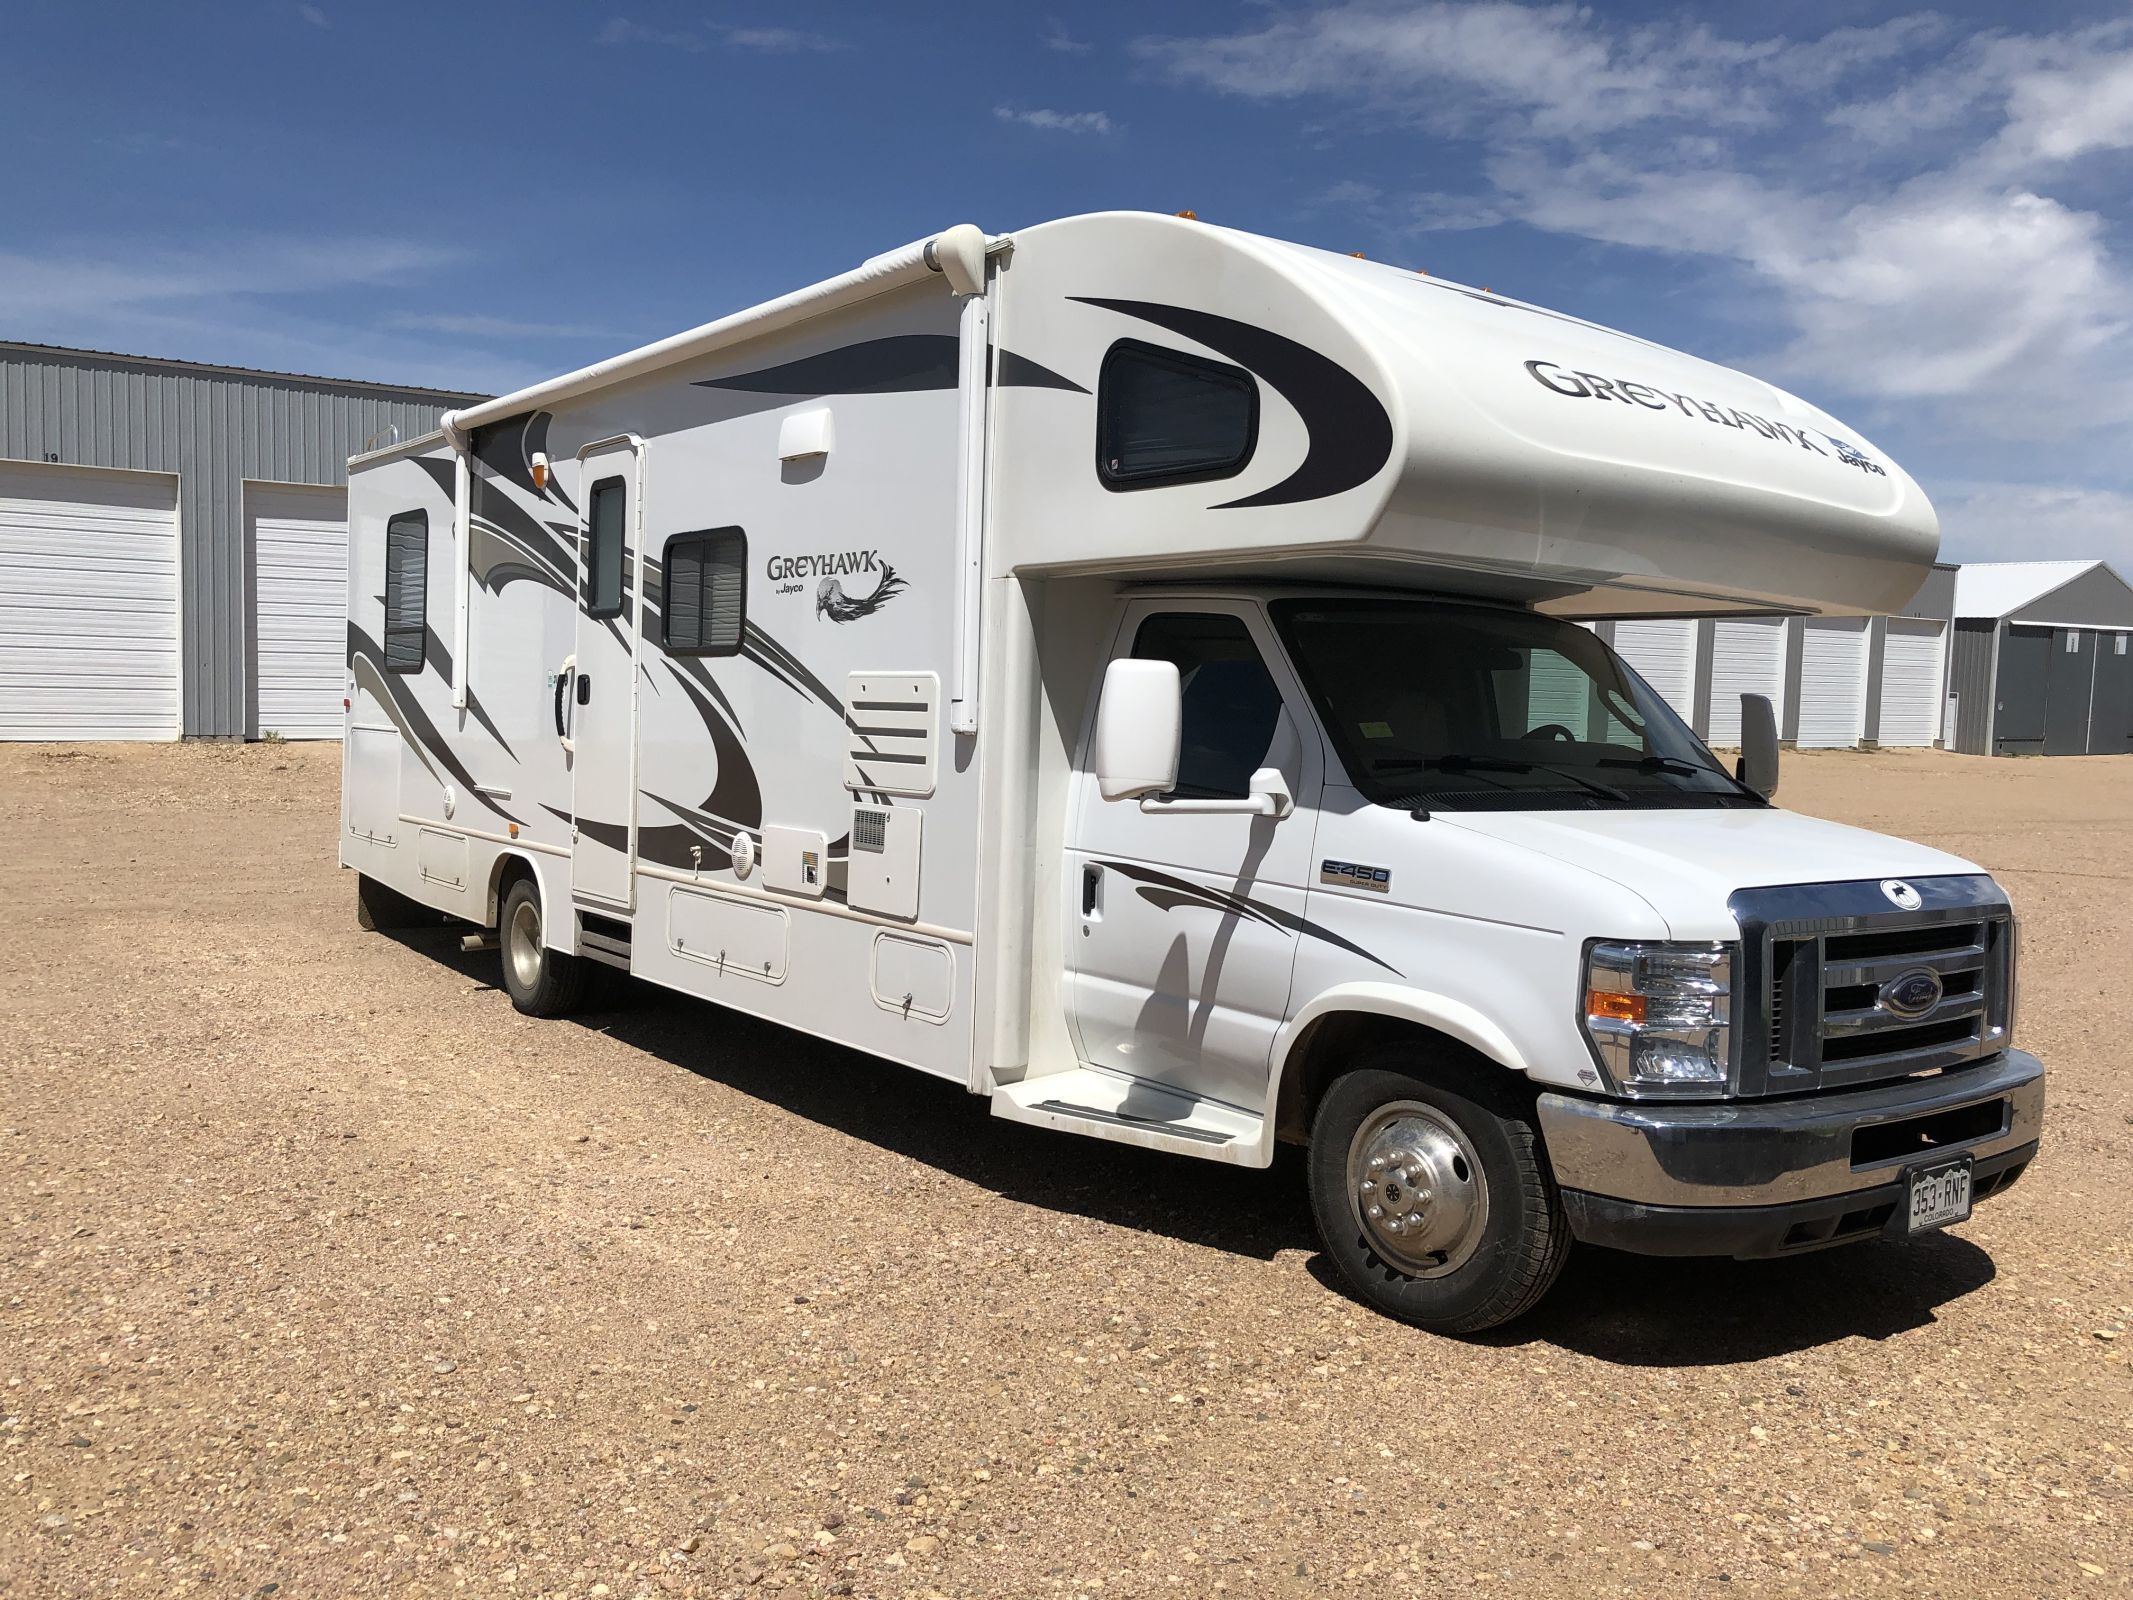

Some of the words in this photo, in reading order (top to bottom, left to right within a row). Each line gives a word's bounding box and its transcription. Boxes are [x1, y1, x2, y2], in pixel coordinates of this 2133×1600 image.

[1524, 360, 1829, 457] GREYHAWK
[1838, 447, 1887, 477] Jayco
[766, 549, 878, 581] GREYHAWK
[780, 582, 804, 596] Jayco
[1923, 1207, 1954, 1223] COLORADO
